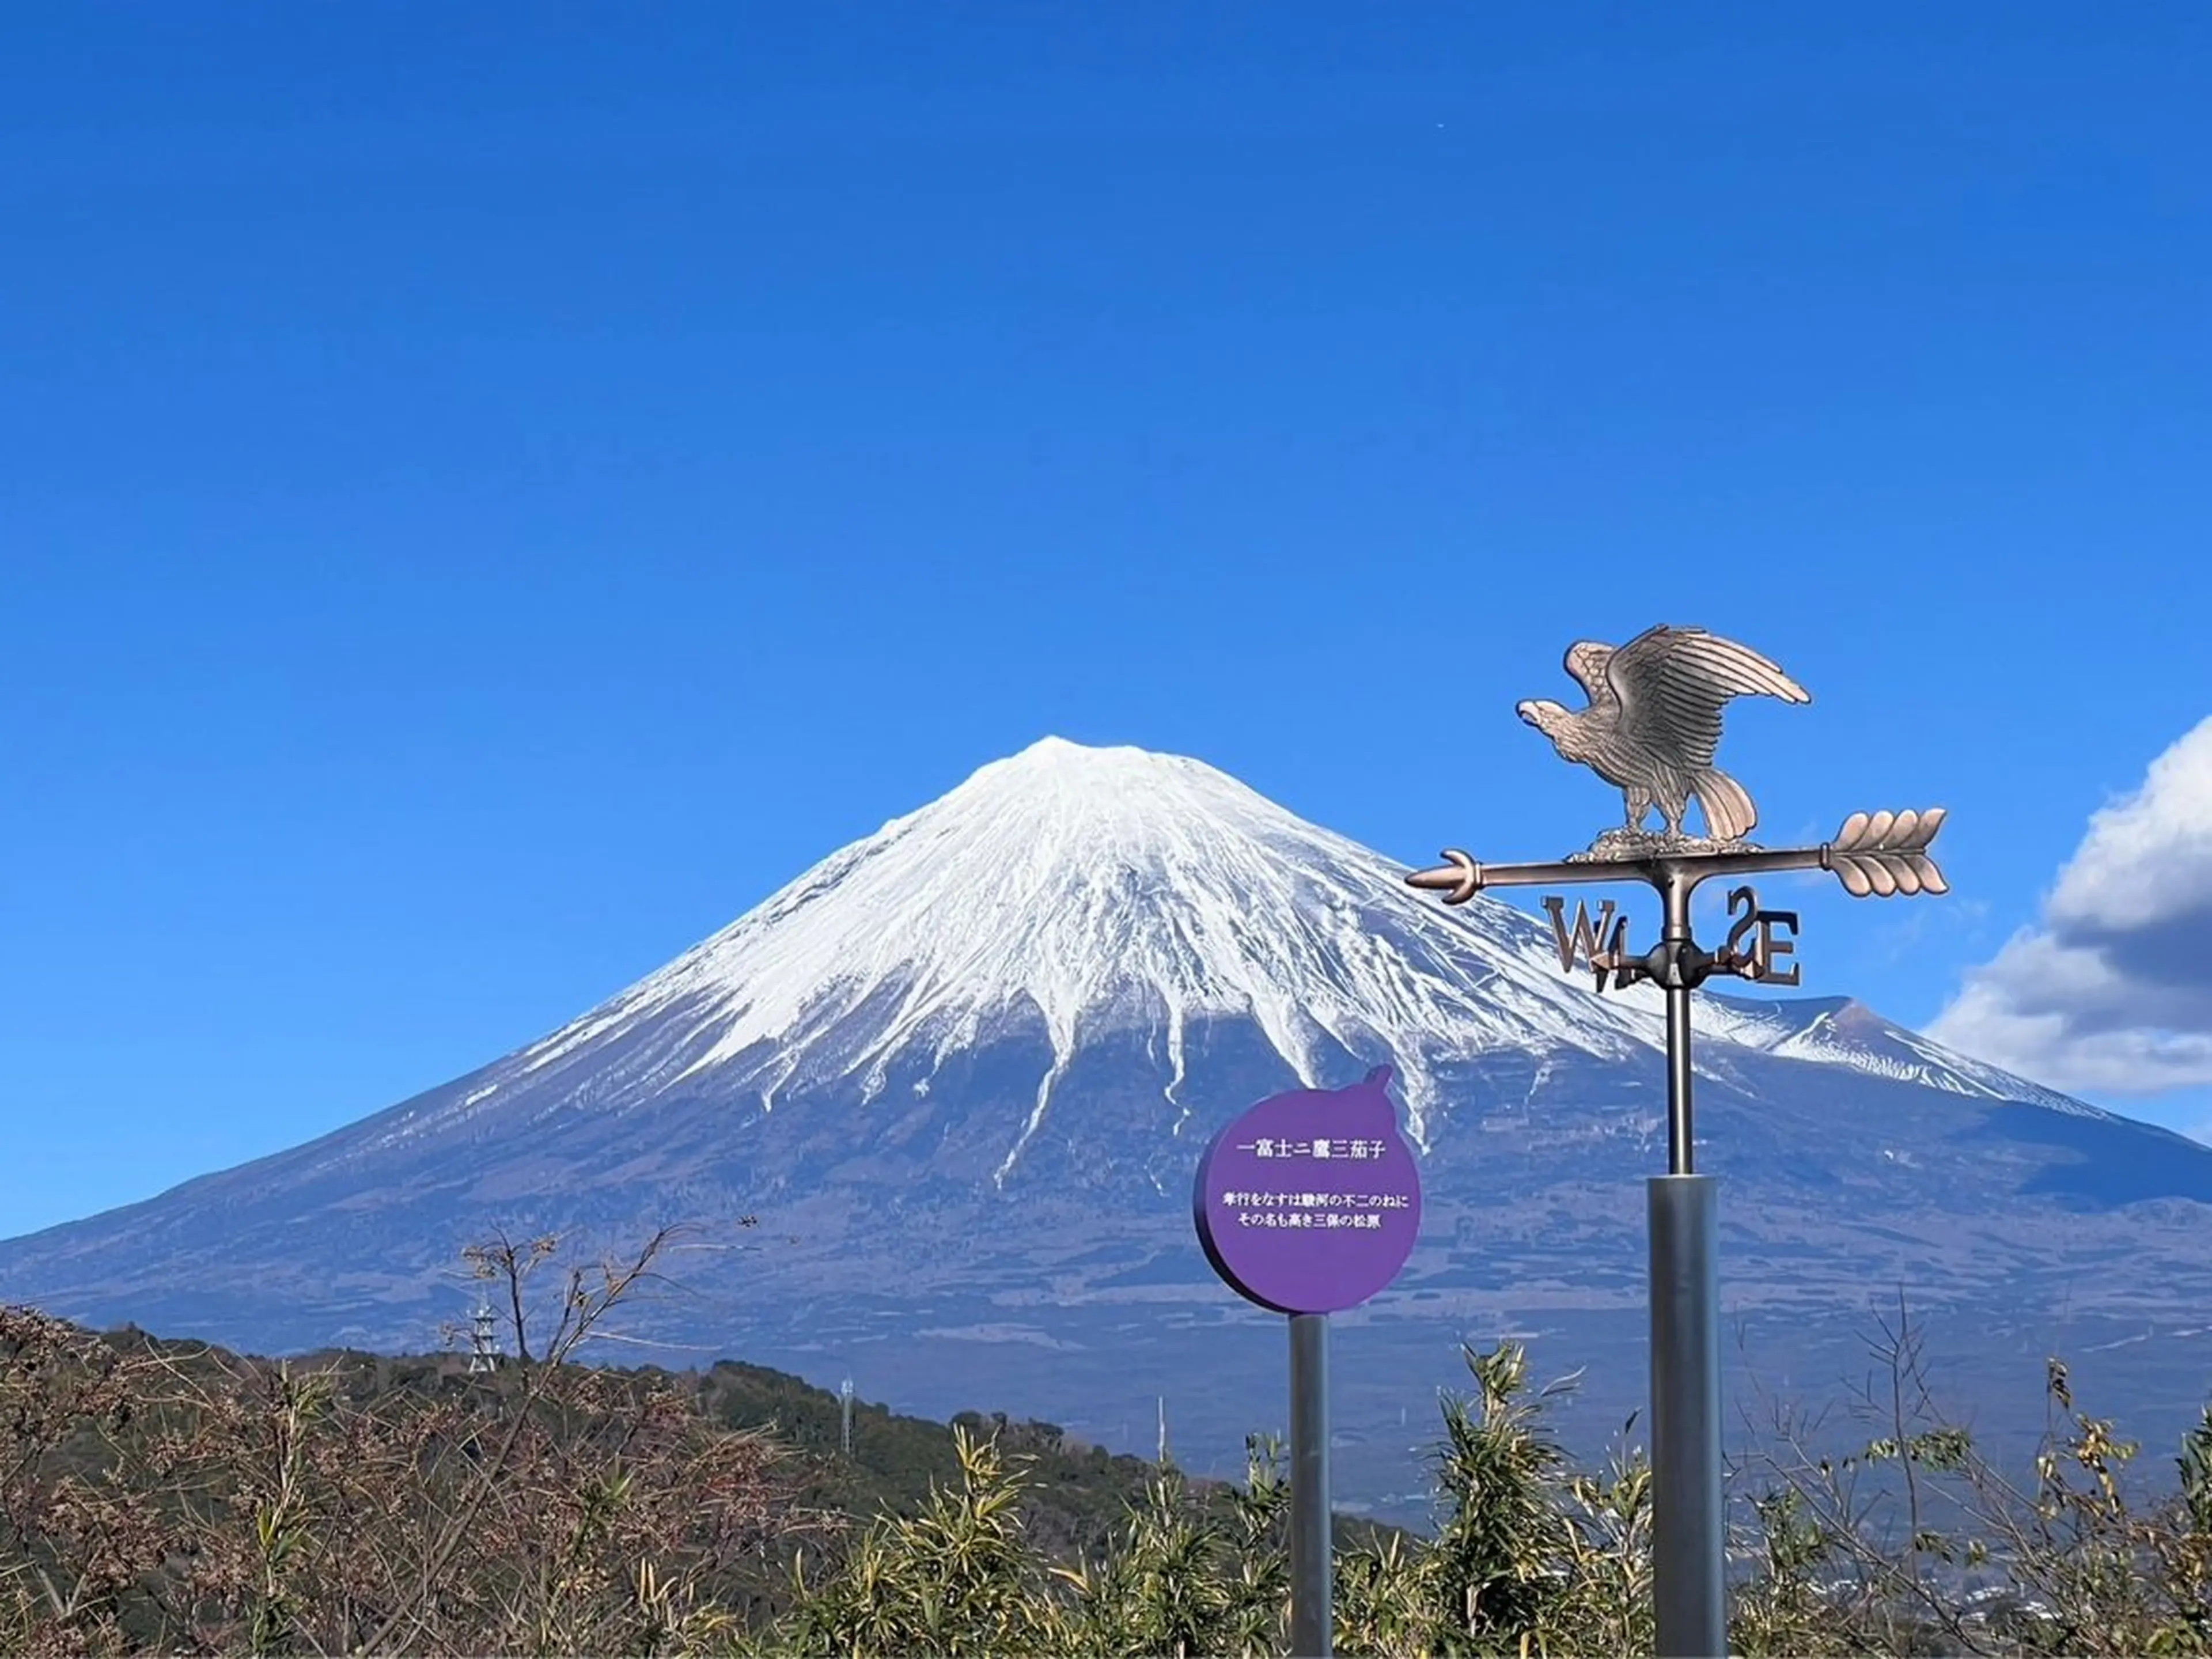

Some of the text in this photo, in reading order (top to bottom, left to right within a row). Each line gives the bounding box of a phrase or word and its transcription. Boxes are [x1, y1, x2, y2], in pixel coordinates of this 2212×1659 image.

[1541, 896, 1615, 973] W
[1756, 910, 1800, 986] E
[1237, 1138, 1386, 1159] 一富士二鷹三茄子
[1238, 1213, 1381, 1229] その名も高き三保の松原
